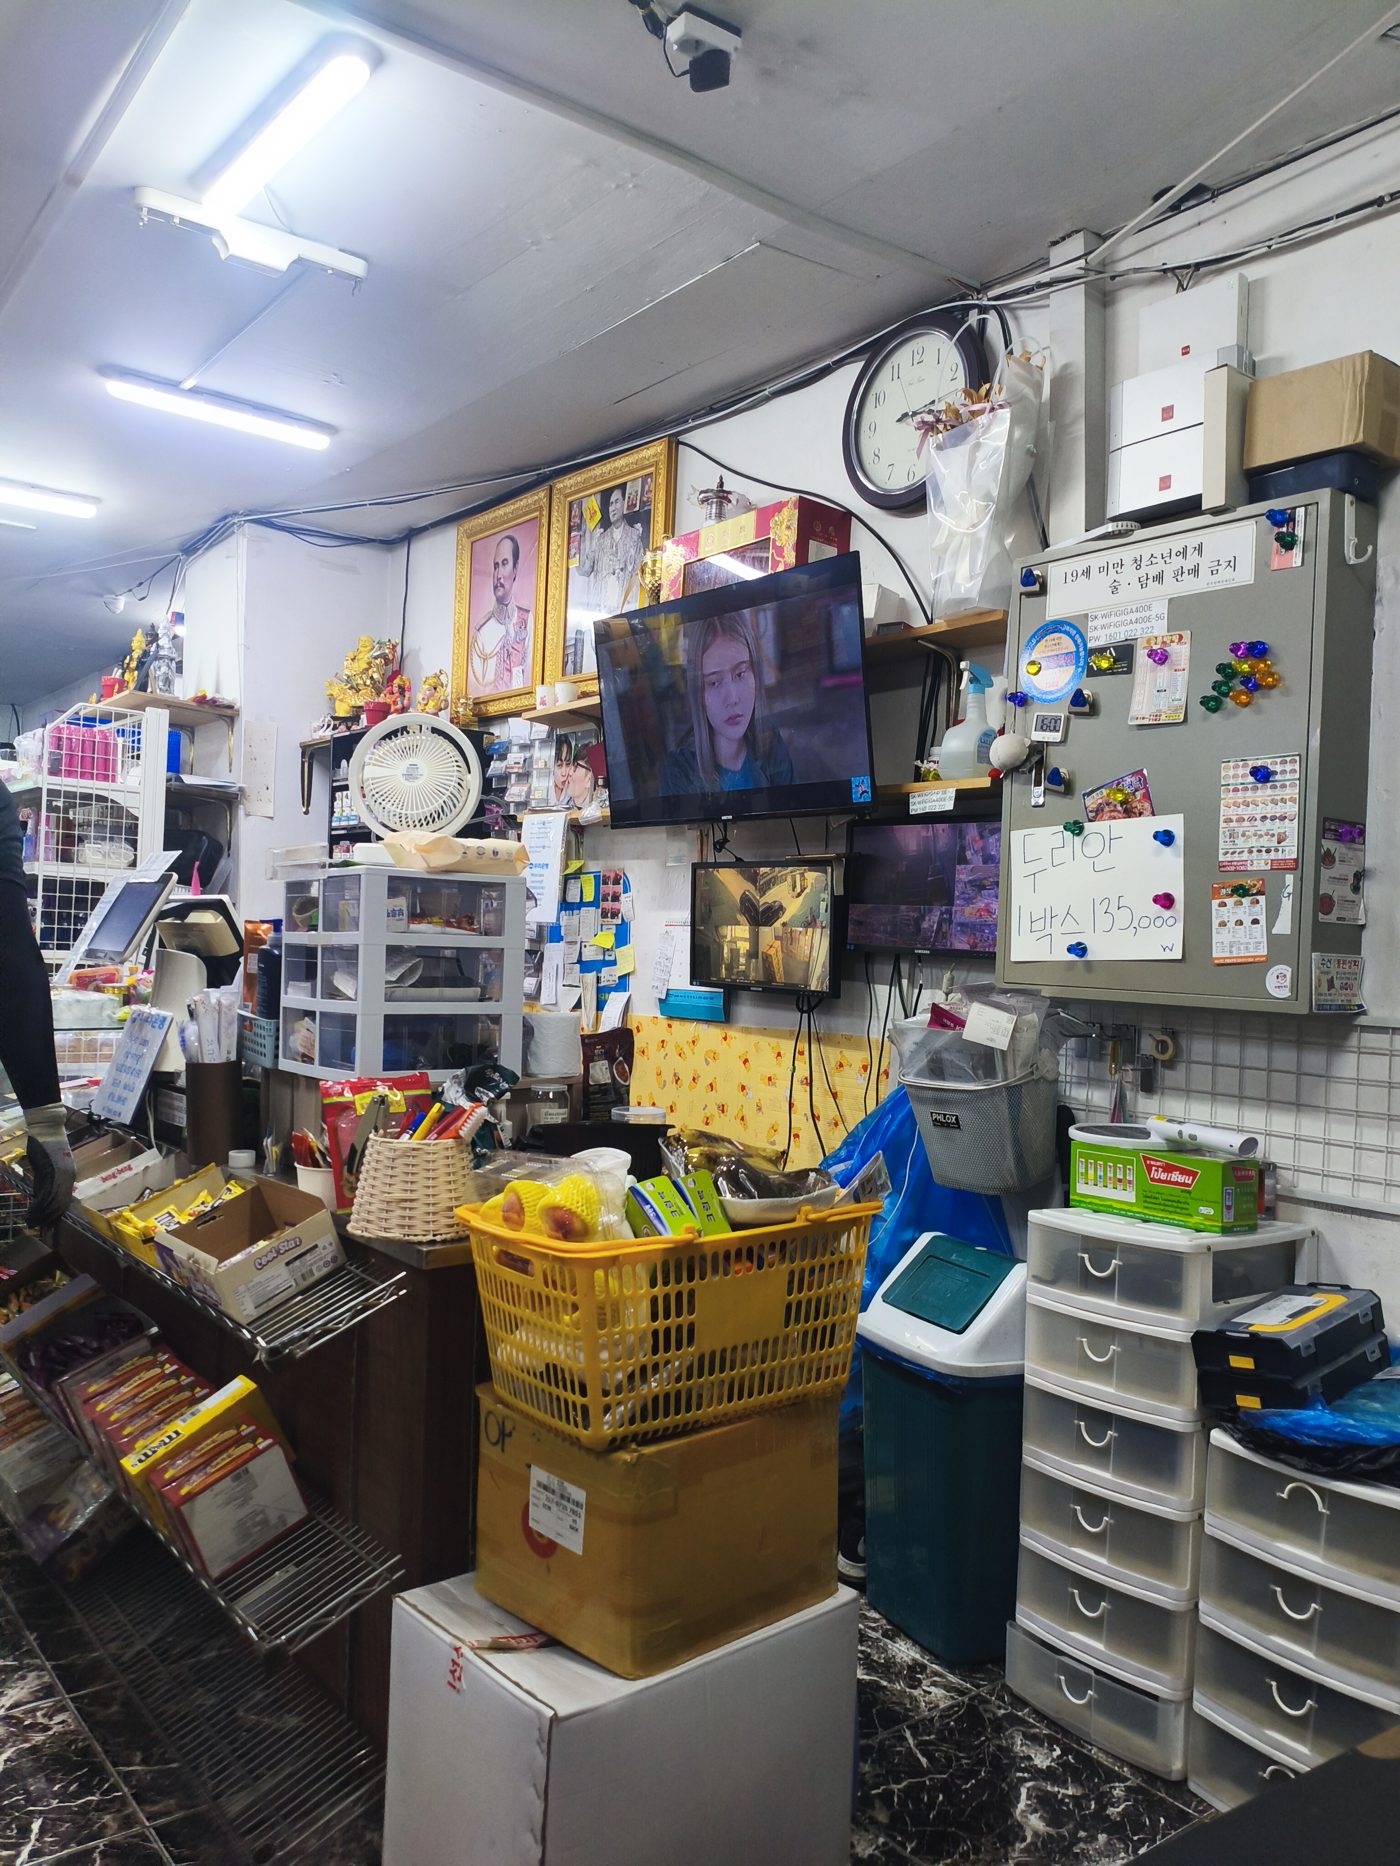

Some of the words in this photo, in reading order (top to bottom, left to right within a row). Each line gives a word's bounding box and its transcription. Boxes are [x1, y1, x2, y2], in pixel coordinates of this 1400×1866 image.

[910, 346, 925, 367] 12
[935, 346, 942, 365] 1
[890, 361, 902, 382] 11
[949, 362, 959, 382] 2
[872, 390, 887, 409] 10
[867, 422, 877, 439] 9
[871, 448, 881, 465] 8
[886, 463, 895, 481] 7
[906, 463, 917, 482] 6
[1062, 565, 1092, 585] 19세
[1098, 558, 1125, 577] 미만
[1131, 541, 1204, 571] 청소년에게
[1108, 577, 1123, 595] 술
[1137, 569, 1164, 590] 담배
[1171, 562, 1201, 584] 판매
[1207, 554, 1238, 577] 금지
[1124, 629, 1138, 638] 022
[1140, 626, 1154, 636] 322
[1022, 825, 1124, 893] 두리안
[1017, 904, 1086, 955] 1박스
[1092, 895, 1178, 937] 135,000
[932, 1113, 957, 1124] PHLOX
[254, 1246, 279, 1271] Cool
